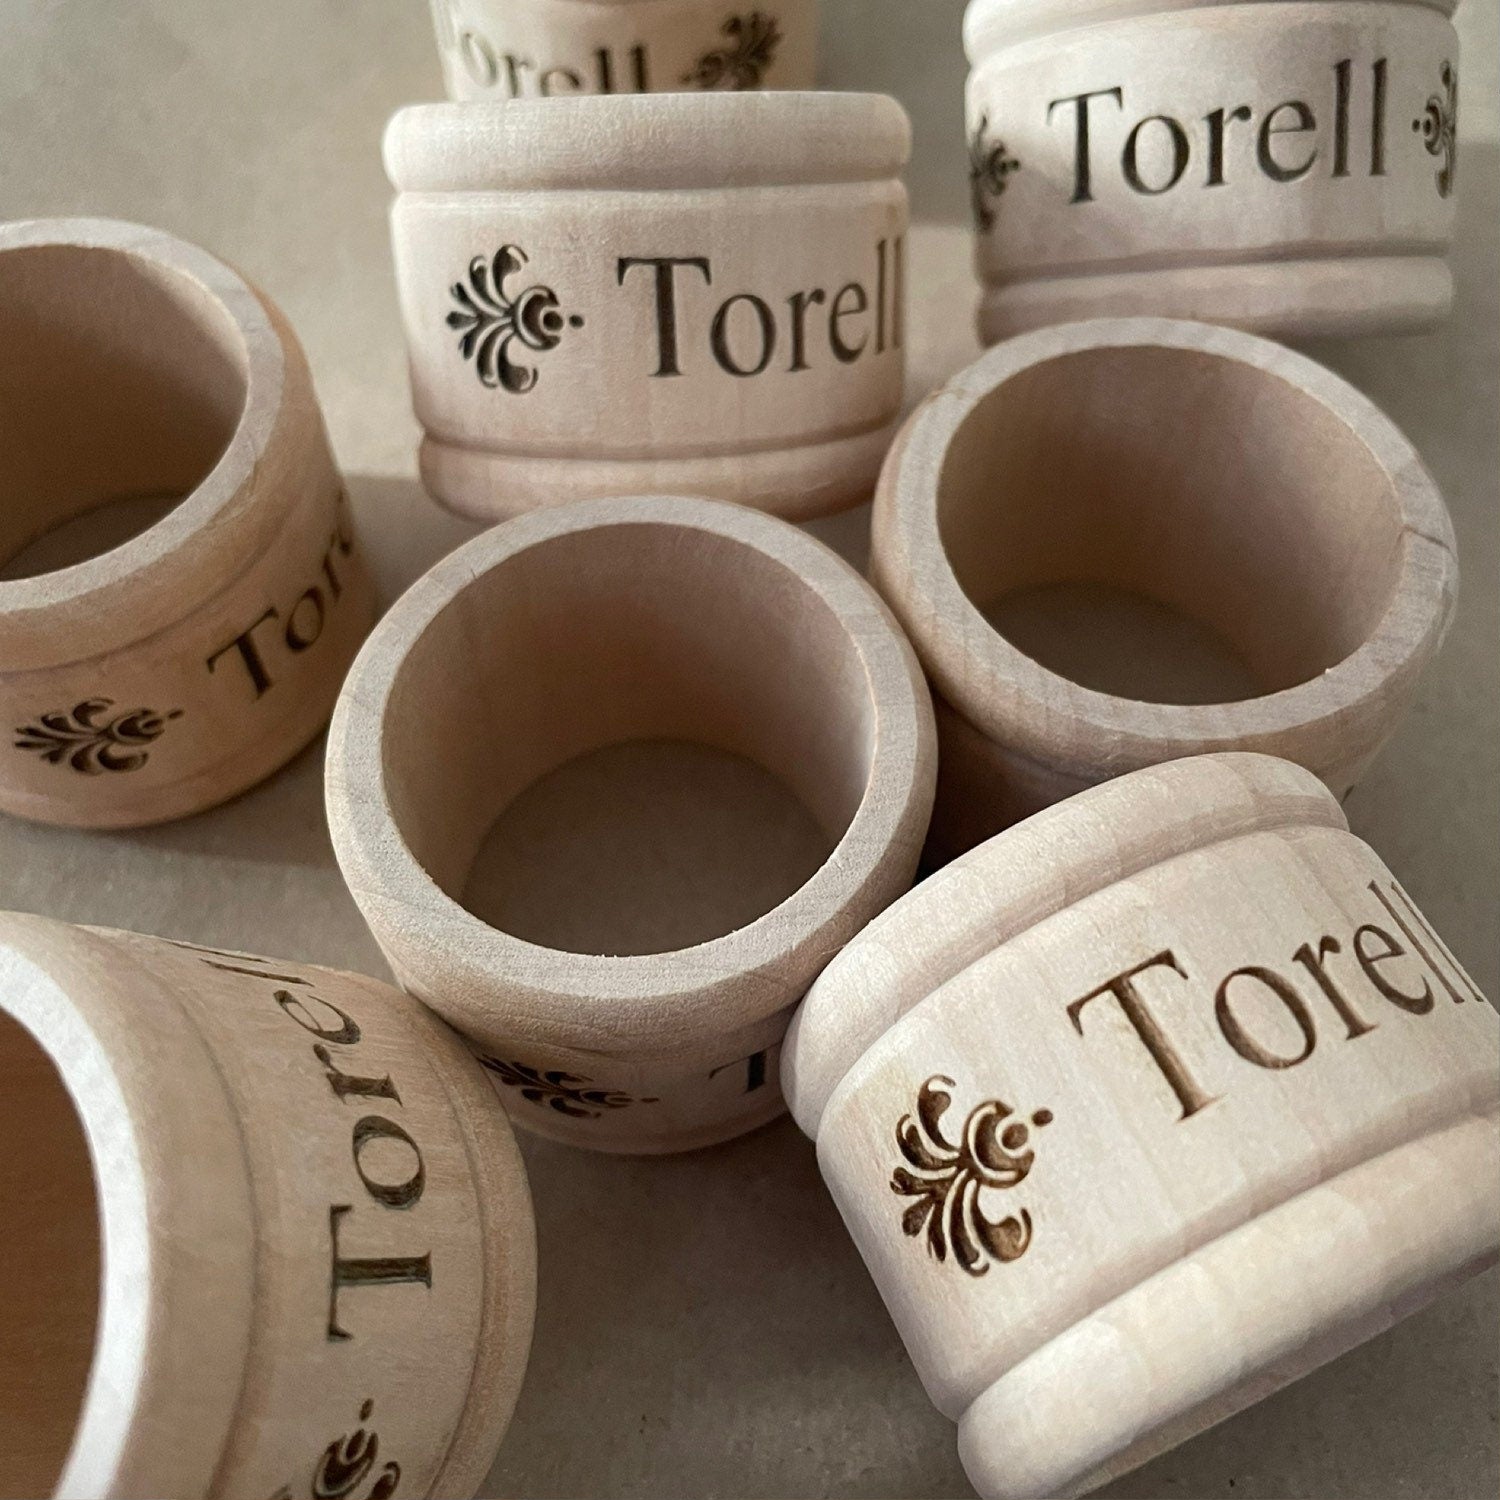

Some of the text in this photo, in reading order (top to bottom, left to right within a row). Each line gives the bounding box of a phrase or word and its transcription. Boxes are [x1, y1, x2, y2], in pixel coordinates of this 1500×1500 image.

[1047, 57, 1388, 205] Torell
[616, 236, 903, 378] Torell
[1065, 879, 1485, 1122] Torell
[164, 938, 433, 1343] Torell
